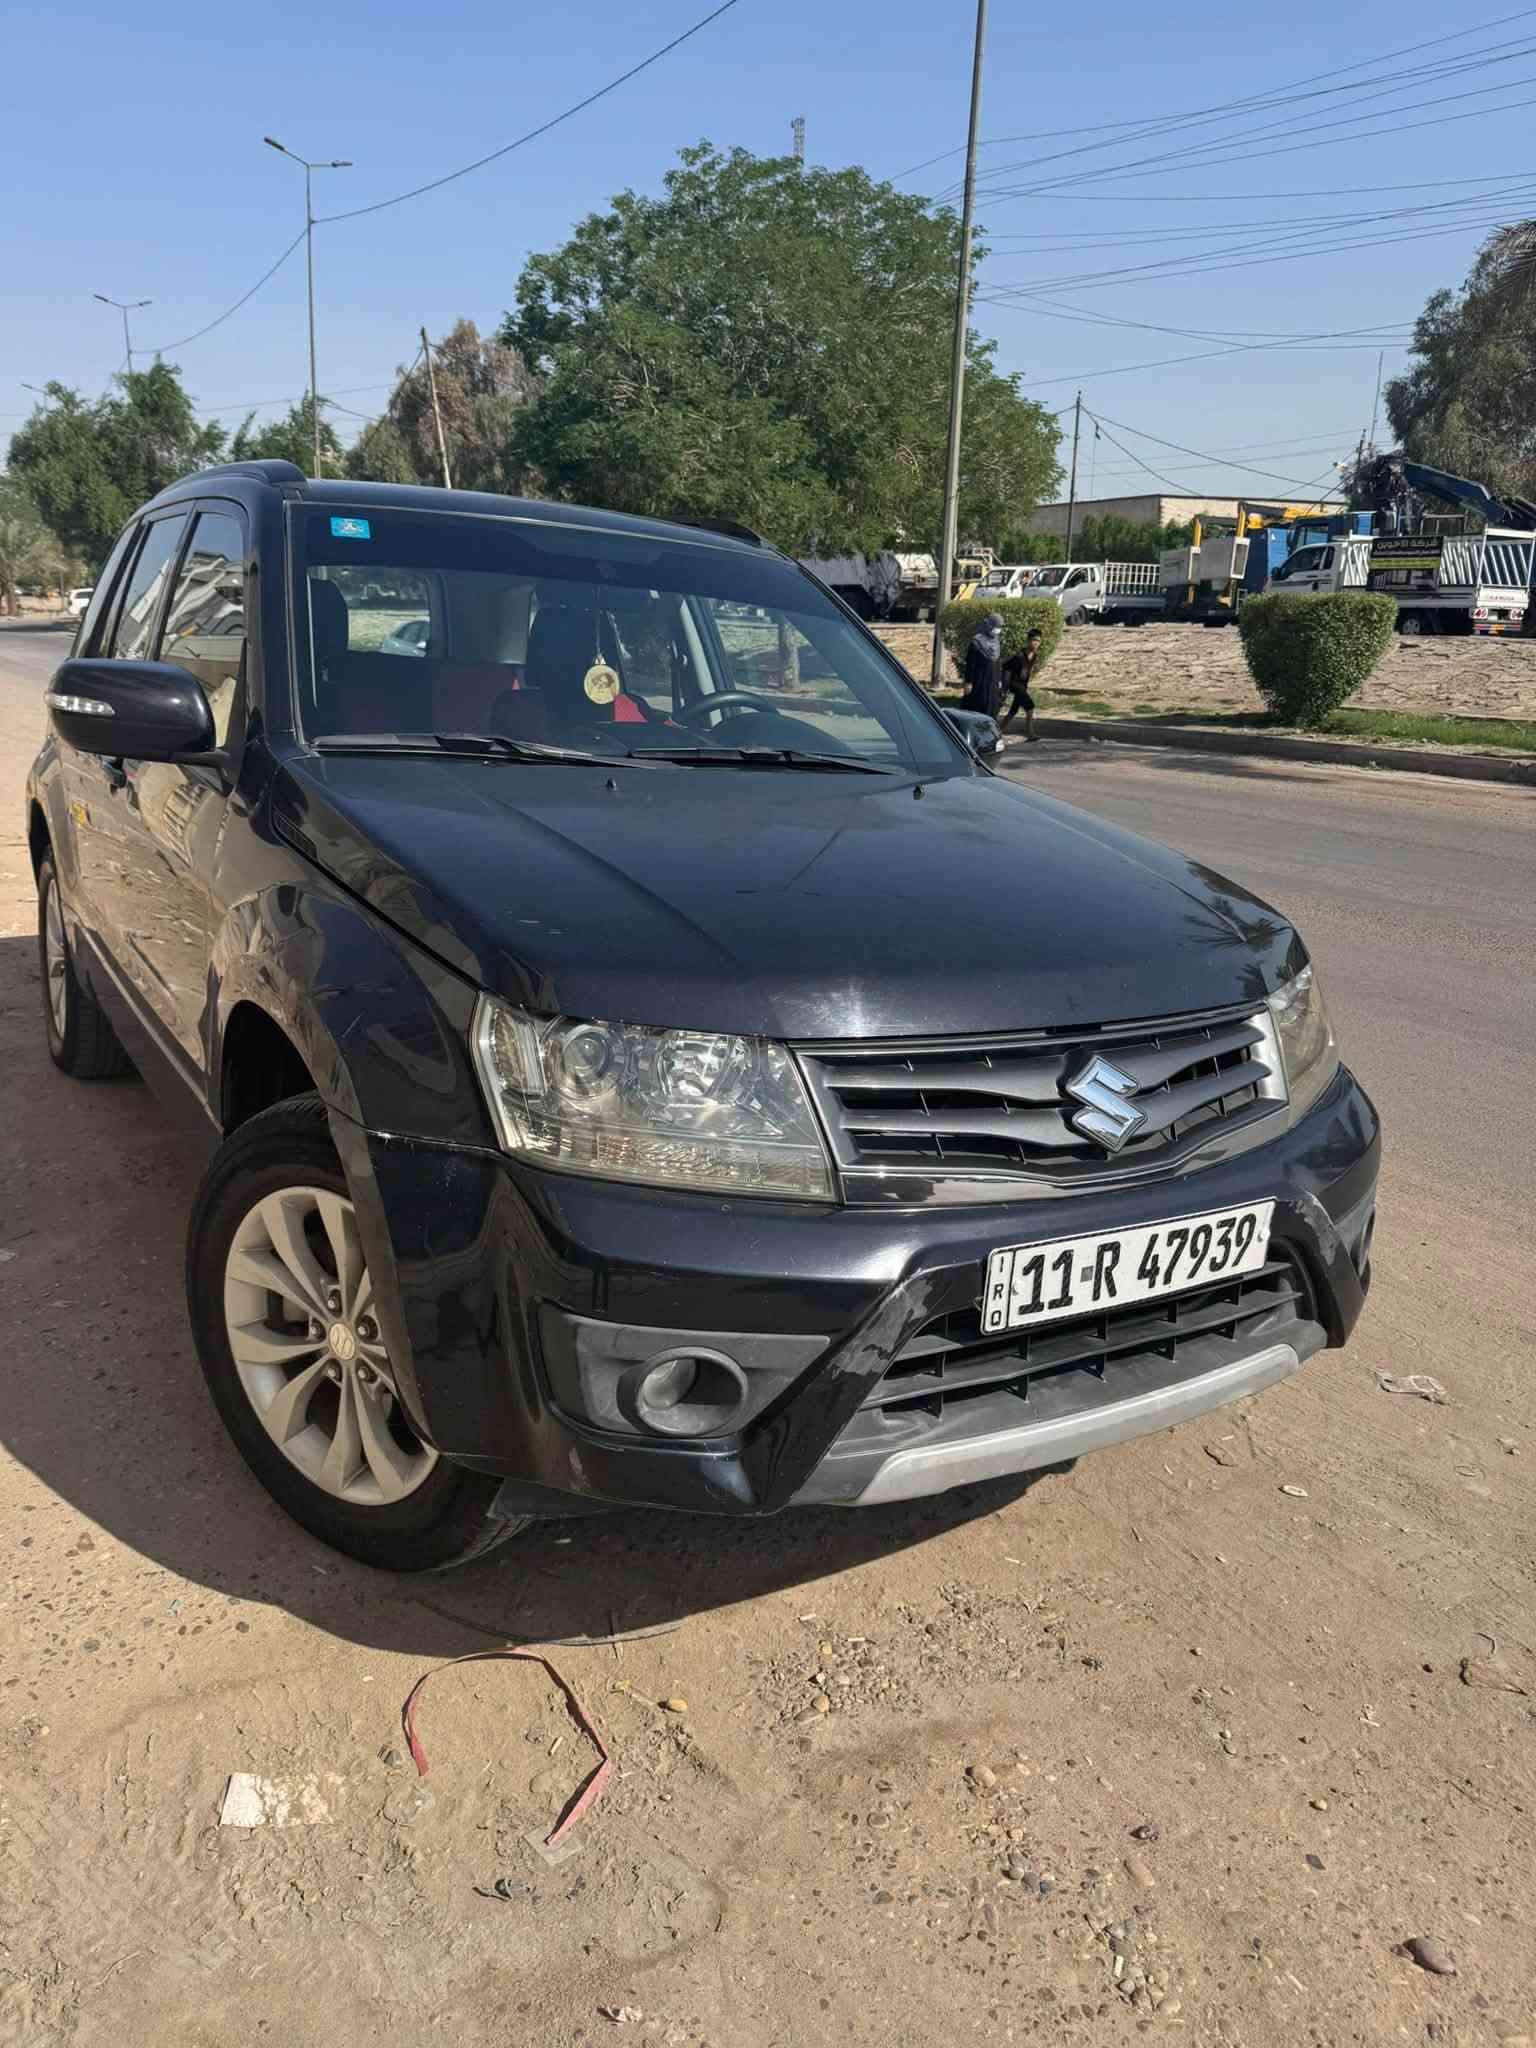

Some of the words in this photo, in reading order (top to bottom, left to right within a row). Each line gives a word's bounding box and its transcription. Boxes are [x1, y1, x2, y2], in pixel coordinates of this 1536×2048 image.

[991, 1256, 1004, 1326] IRQ
[1018, 1249, 1075, 1315] 11
[1092, 1241, 1121, 1301] R
[1137, 1213, 1257, 1289] 47939
